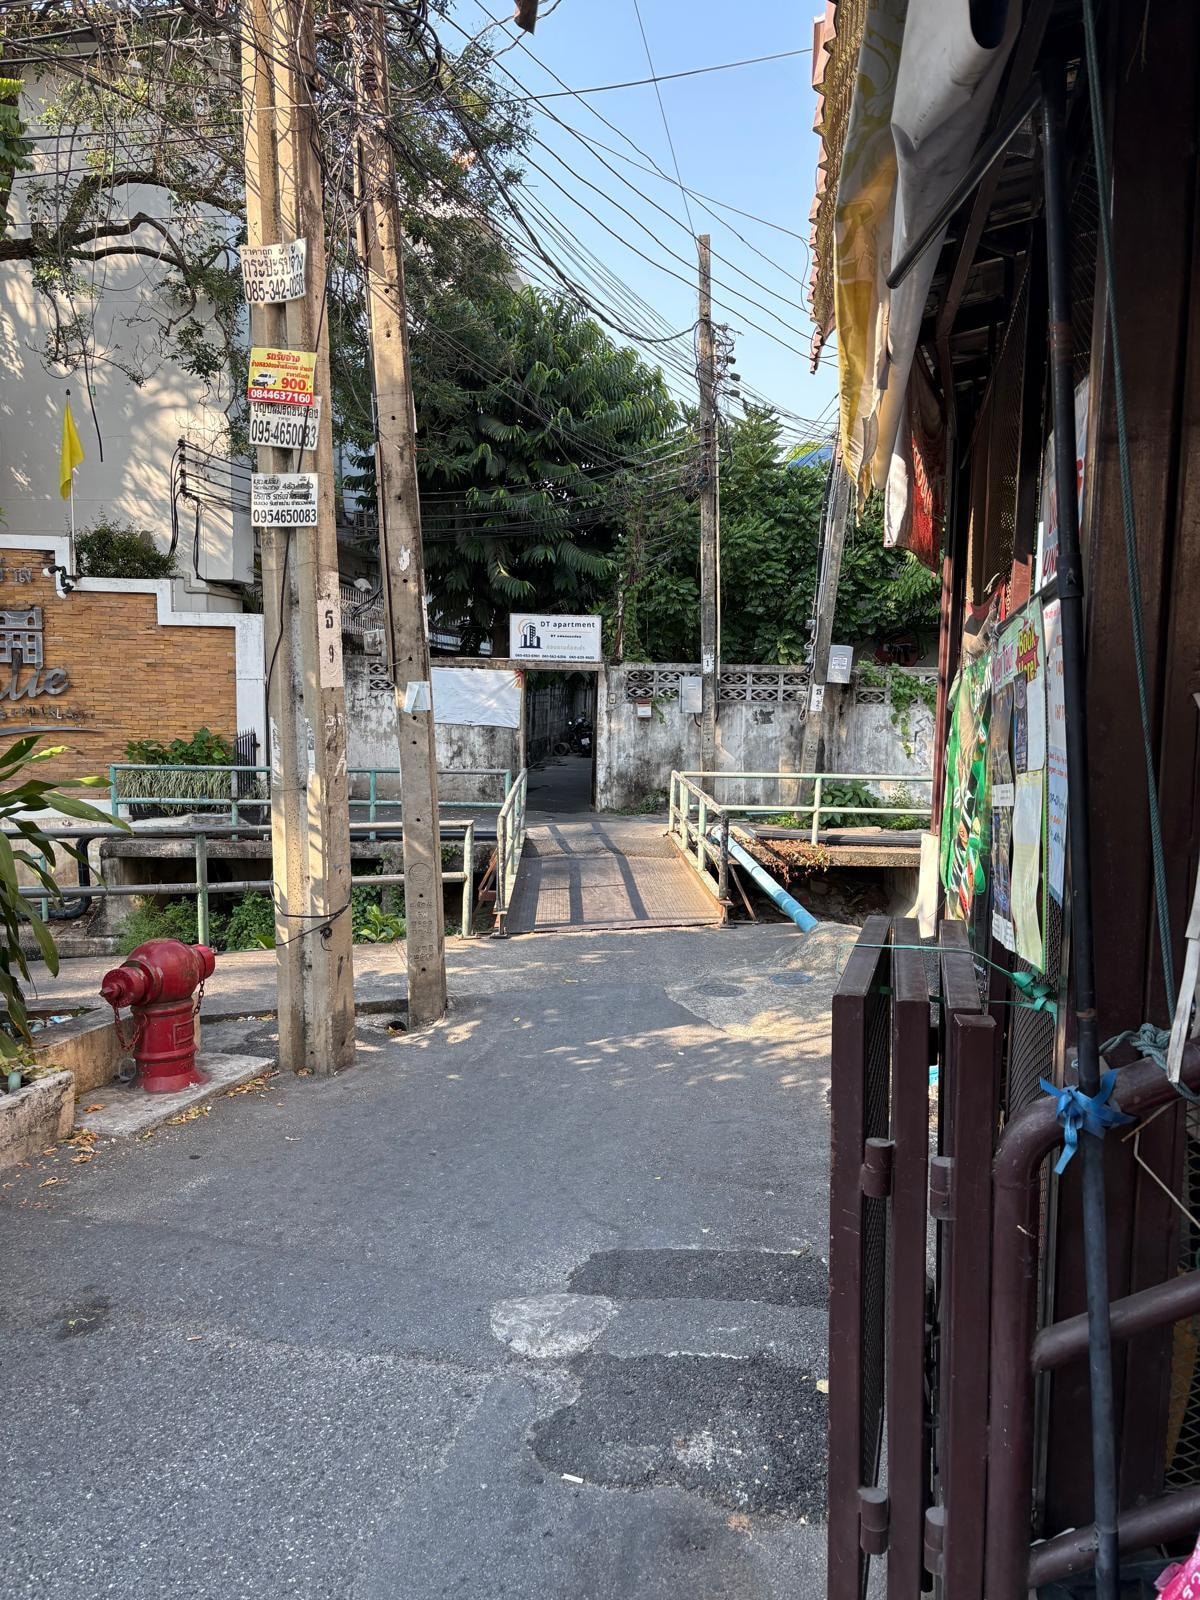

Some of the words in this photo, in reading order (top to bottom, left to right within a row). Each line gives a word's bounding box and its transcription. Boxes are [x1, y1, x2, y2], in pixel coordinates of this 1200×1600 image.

[251, 389, 311, 403] 0844637160
[251, 419, 317, 447] 095-4650083
[253, 509, 317, 523] 0954650083
[553, 621, 595, 629] apartment
